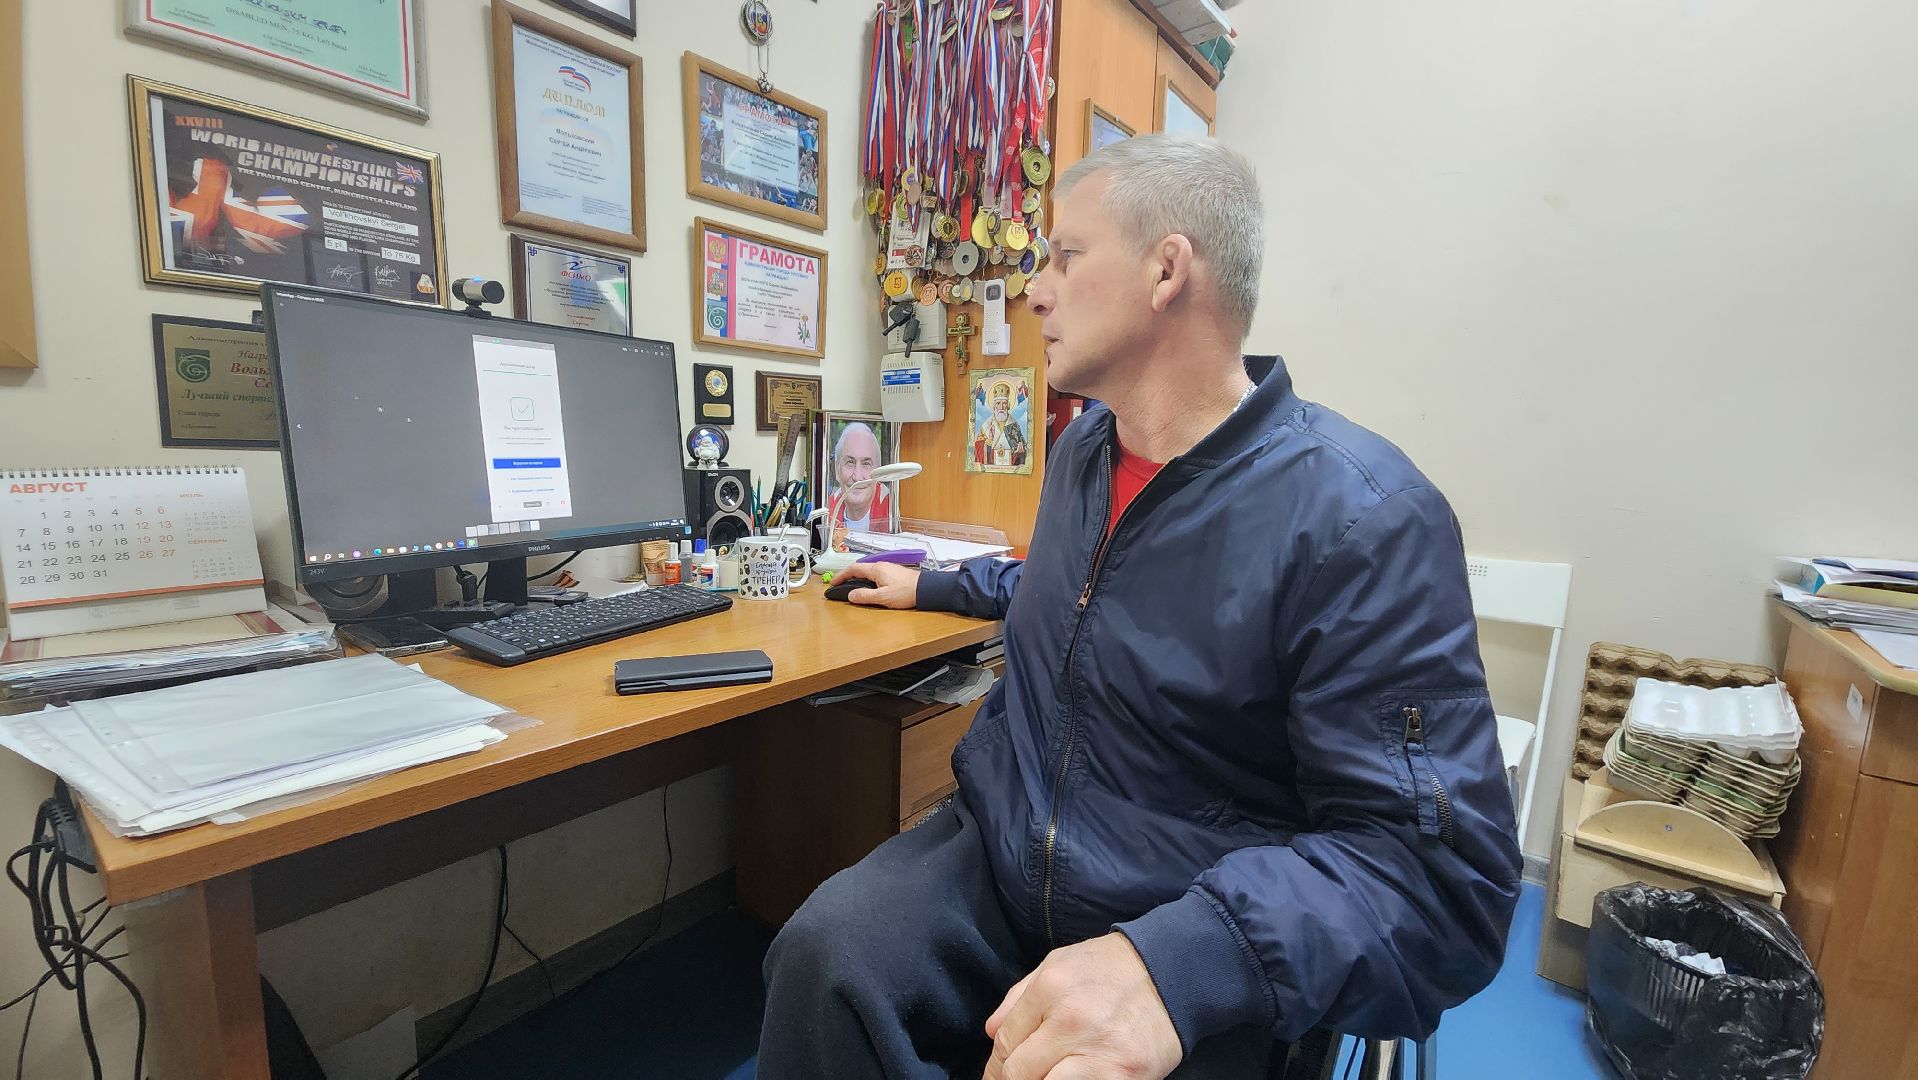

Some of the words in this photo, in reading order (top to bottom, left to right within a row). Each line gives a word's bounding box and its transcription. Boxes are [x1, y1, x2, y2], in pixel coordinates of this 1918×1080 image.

[226, 6, 268, 24] DISABLED
[542, 88, 606, 118] ДИПЛОМ
[175, 115, 224, 129] XXVIII
[190, 128, 260, 152] WORLD
[238, 151, 416, 197] CHAMPIONSHIPS
[740, 242, 816, 275] ГРАМОТА
[560, 270, 592, 282] ФСИМО
[181, 388, 230, 400] Лучший
[10, 482, 88, 494] АВГУСТ
[19, 529, 24, 537] 7
[43, 528, 50, 536] 8
[17, 544, 31, 552] 14
[41, 542, 56, 551] 15
[66, 541, 80, 549] 16
[528, 544, 550, 552] PHILIPS
[18, 560, 32, 569] 21
[43, 558, 58, 566] 22
[67, 556, 82, 564] 23
[91, 555, 106, 563] 24
[20, 576, 35, 584] 28
[45, 574, 60, 582] 29
[69, 572, 84, 580] 30
[750, 575, 780, 585] ТРЕНЕР
